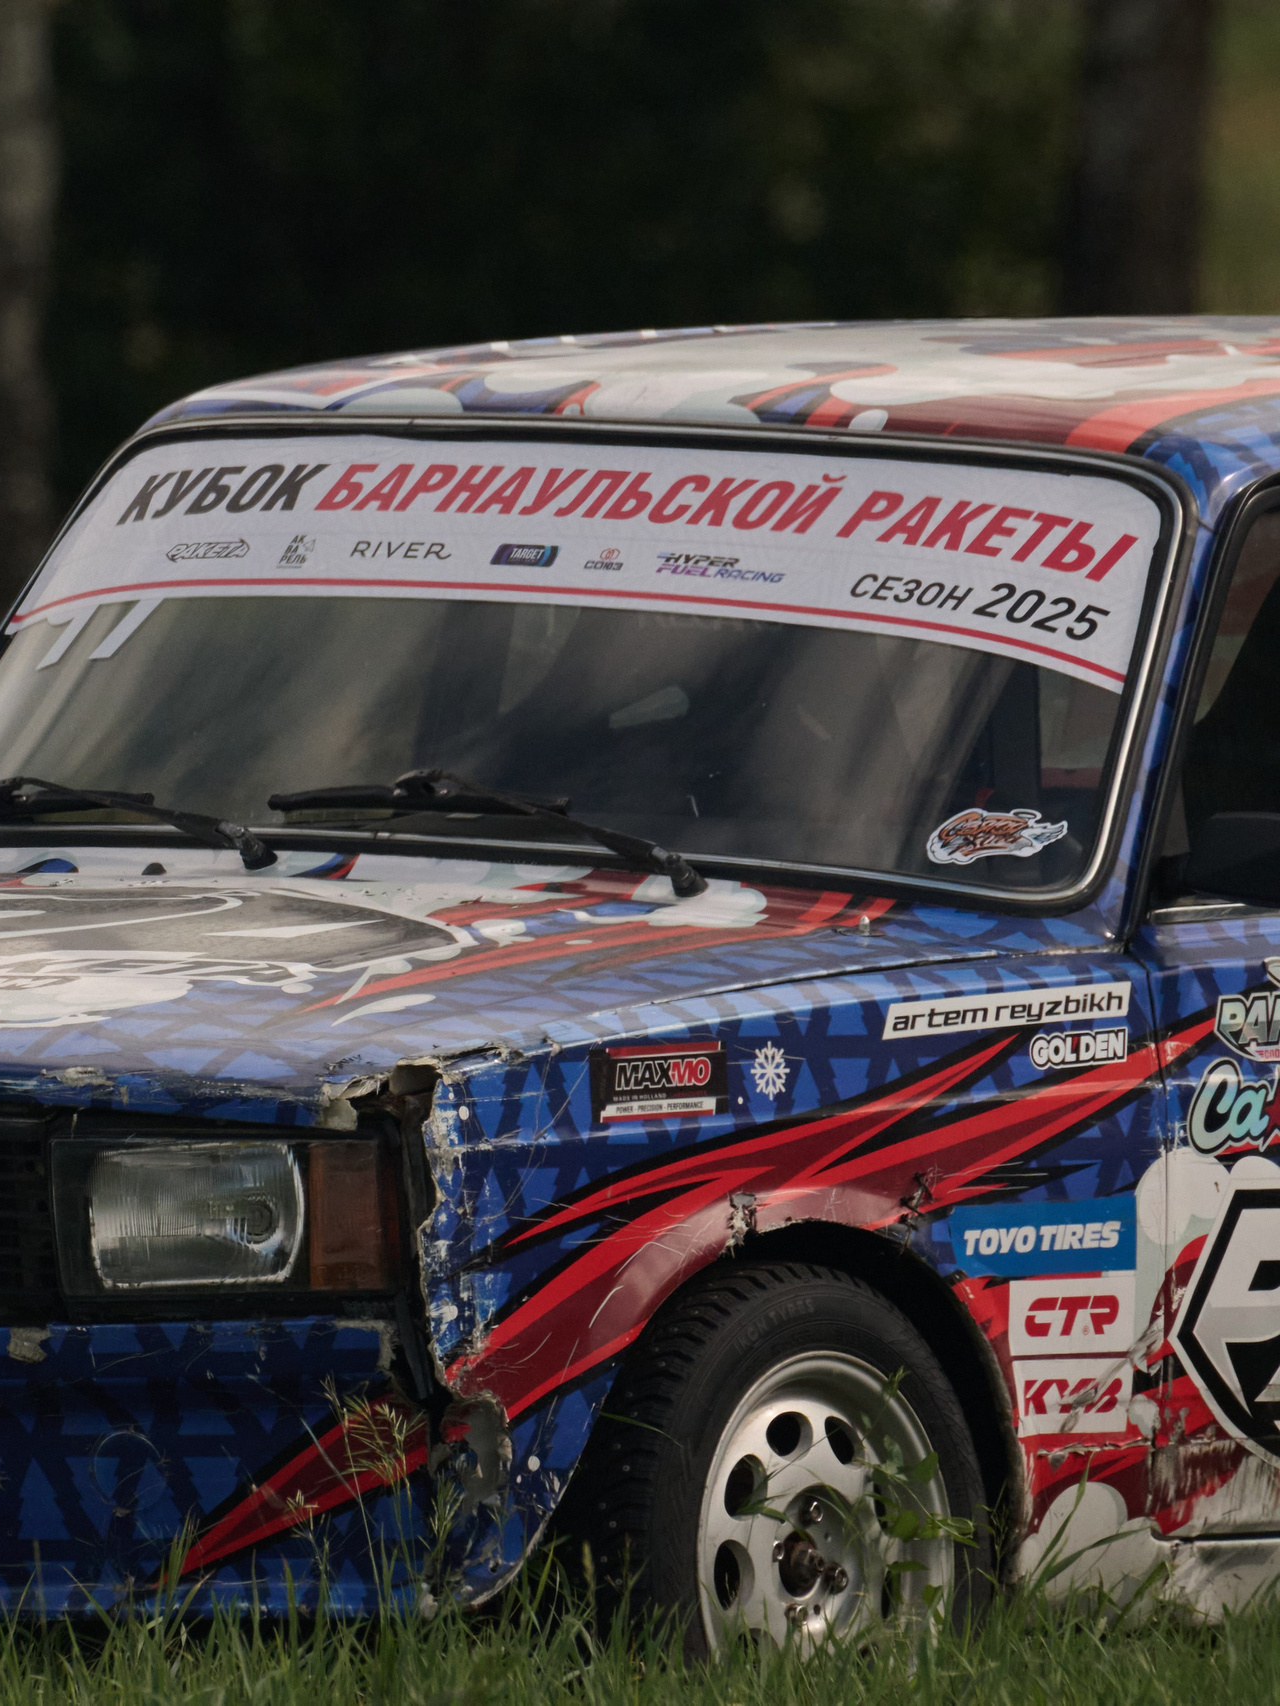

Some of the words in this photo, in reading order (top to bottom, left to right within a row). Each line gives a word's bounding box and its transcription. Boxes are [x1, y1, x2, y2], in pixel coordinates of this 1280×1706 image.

[116, 463, 331, 526] КУБОК
[313, 463, 847, 535] БАРНАУЛЬСКОЙ
[835, 490, 1139, 582] РАКЕТЫ
[350, 540, 452, 560] RIVER
[509, 548, 545, 560] TARGET
[662, 552, 741, 568] HYPER
[850, 573, 974, 611] СЕЗОН
[972, 582, 1111, 641] 2025
[892, 1003, 989, 1032] artem
[994, 991, 1124, 1023] reyzbikh
[615, 1057, 711, 1091] MAXMO
[616, 1104, 634, 1114] POWER
[638, 1103, 663, 1113] PRECISION
[666, 1100, 704, 1111] PERFORMANCE
[640, 1092, 667, 1100] HOLLAND
[963, 1226, 1037, 1256] TOYO
[1039, 1221, 1121, 1250] TIRES
[1024, 1295, 1120, 1337] CTR
[1024, 1378, 1123, 1416] KYB
